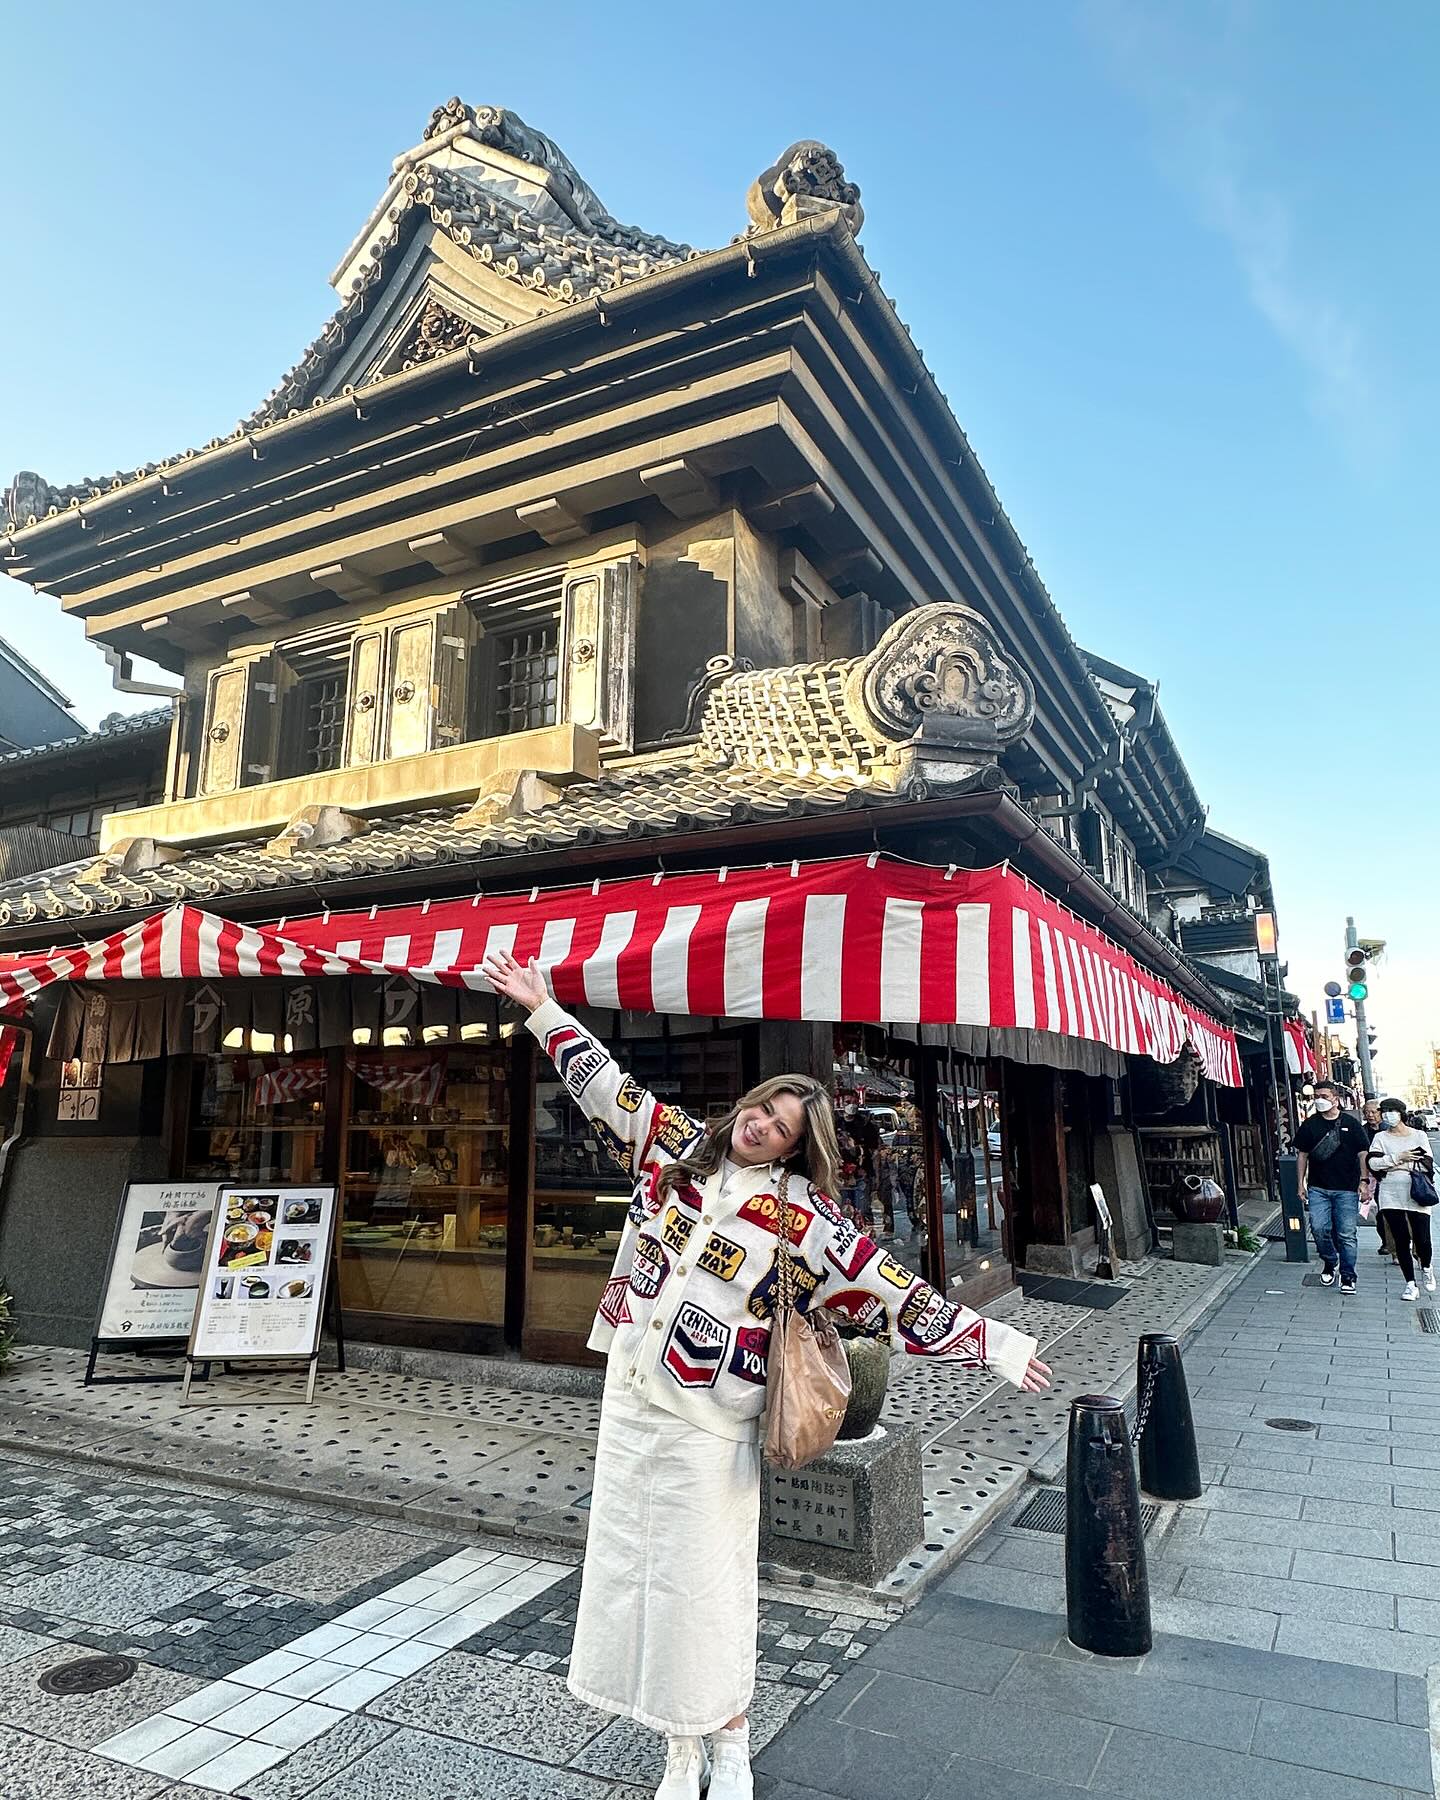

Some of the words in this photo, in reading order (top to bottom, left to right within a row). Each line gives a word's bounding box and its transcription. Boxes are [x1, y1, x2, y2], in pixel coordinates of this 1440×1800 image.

[568, 1051, 603, 1092] CENTRAL
[663, 1224, 687, 1250] THE
[681, 1308, 724, 1344] CENTRAL
